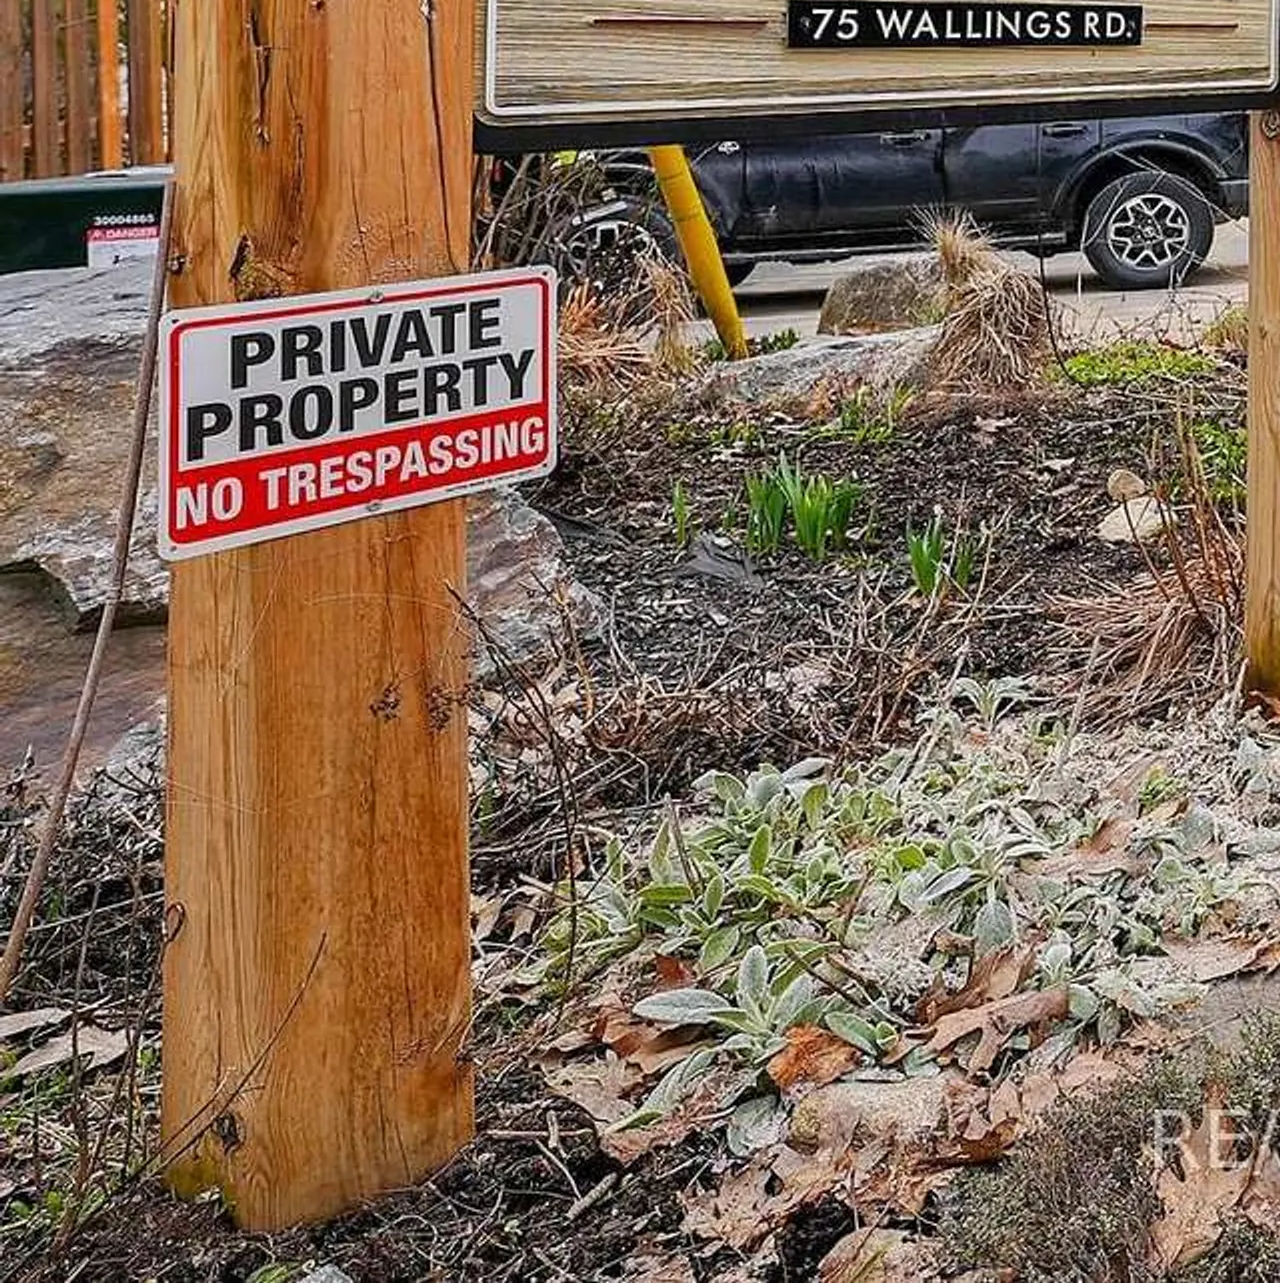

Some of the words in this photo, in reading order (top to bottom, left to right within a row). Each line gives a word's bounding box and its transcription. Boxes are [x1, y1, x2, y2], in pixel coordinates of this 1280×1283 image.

[811, 8, 859, 40] 75
[876, 8, 1072, 39] WALLINGS
[1084, 11, 1133, 39] RD.
[230, 298, 502, 390] PRIVATE
[186, 349, 535, 463] PROPERTY
[176, 475, 244, 530] NO
[260, 417, 545, 512] TRESPASSING
